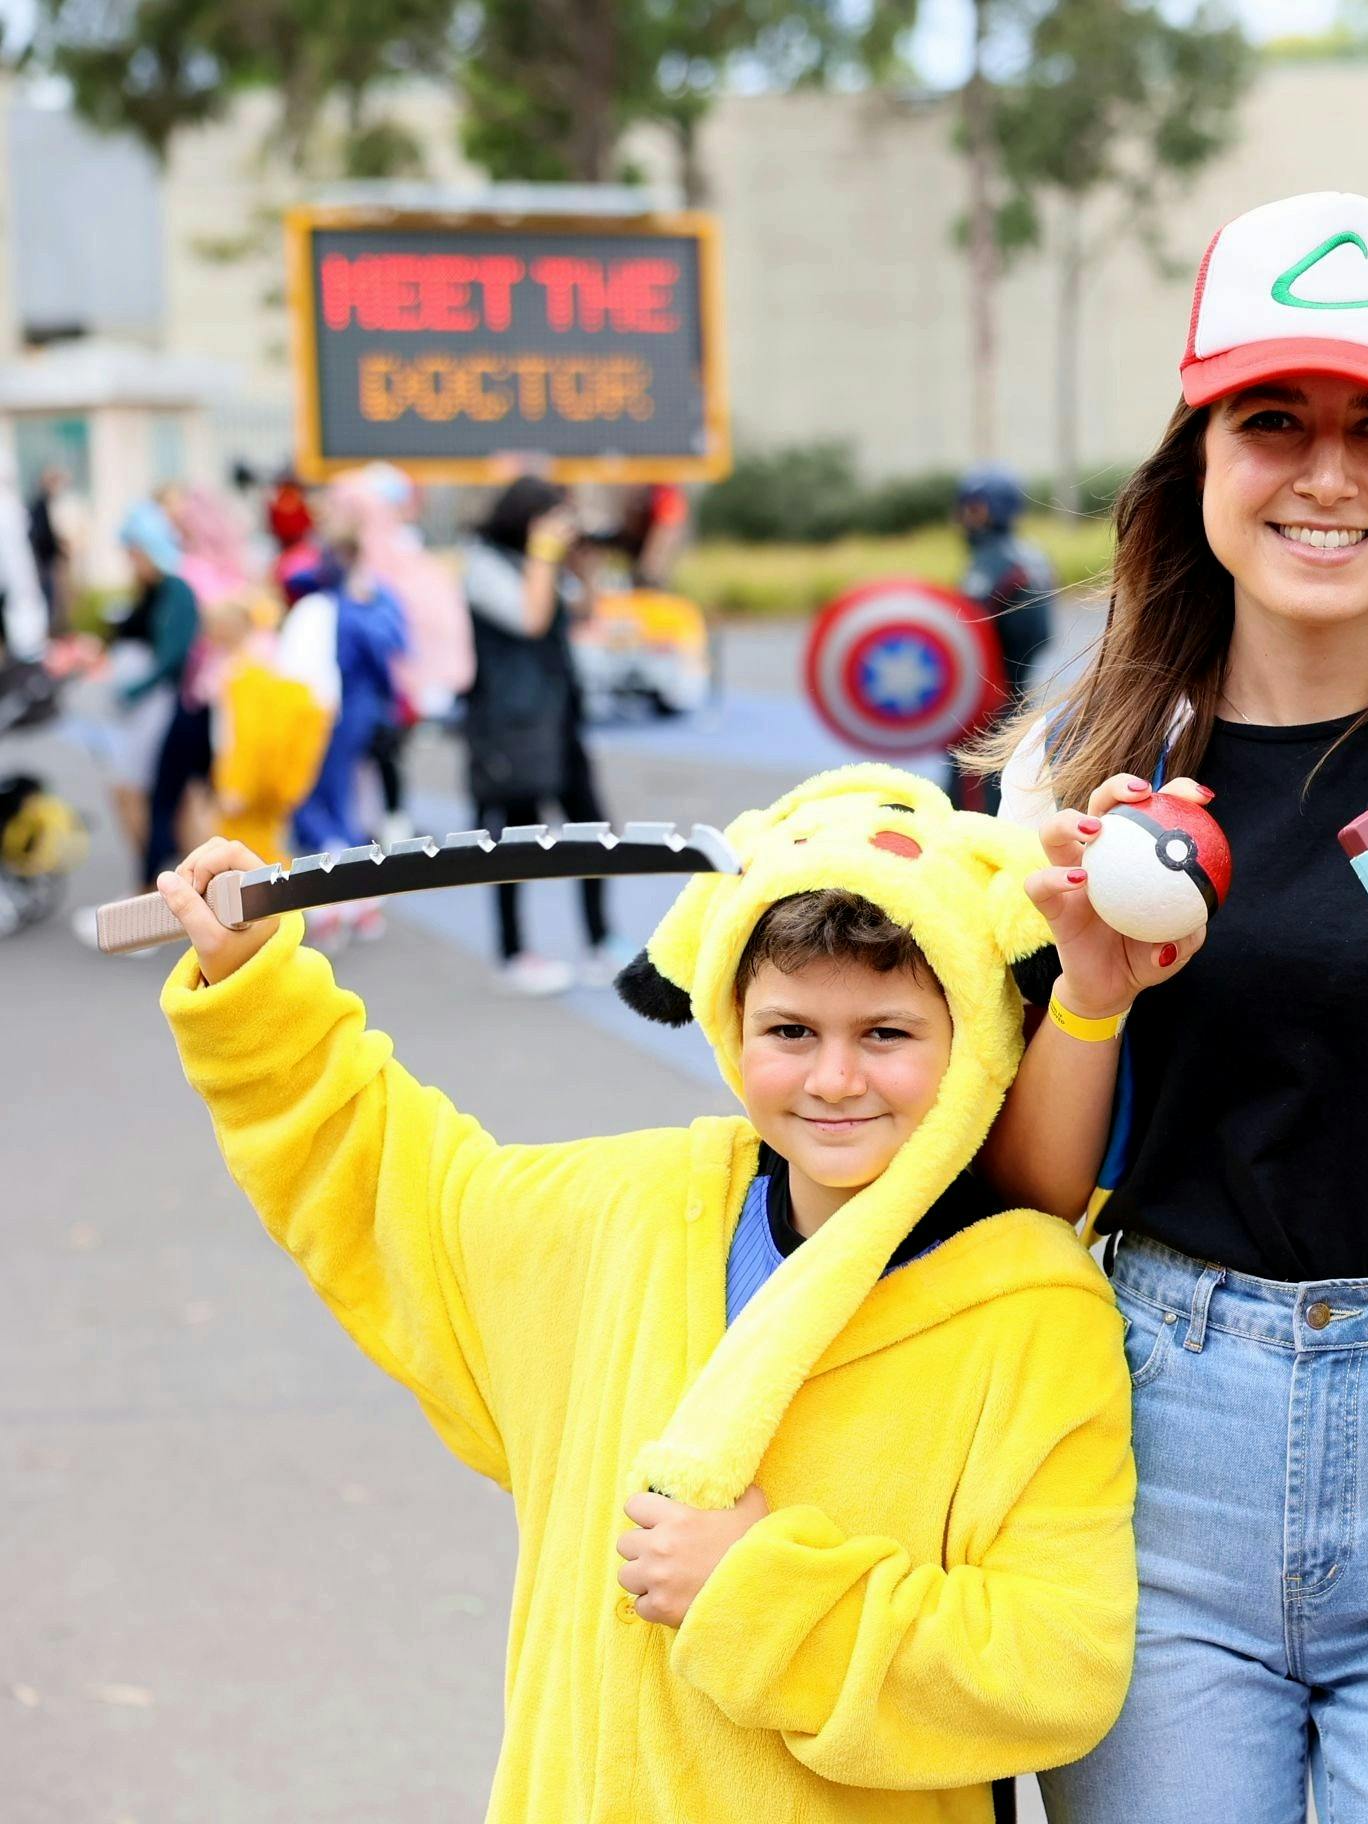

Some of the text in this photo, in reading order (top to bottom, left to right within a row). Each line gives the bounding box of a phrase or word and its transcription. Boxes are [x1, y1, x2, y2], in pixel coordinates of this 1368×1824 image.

[321, 253, 680, 333] MEET THE
[358, 352, 655, 422] DOCTOR
